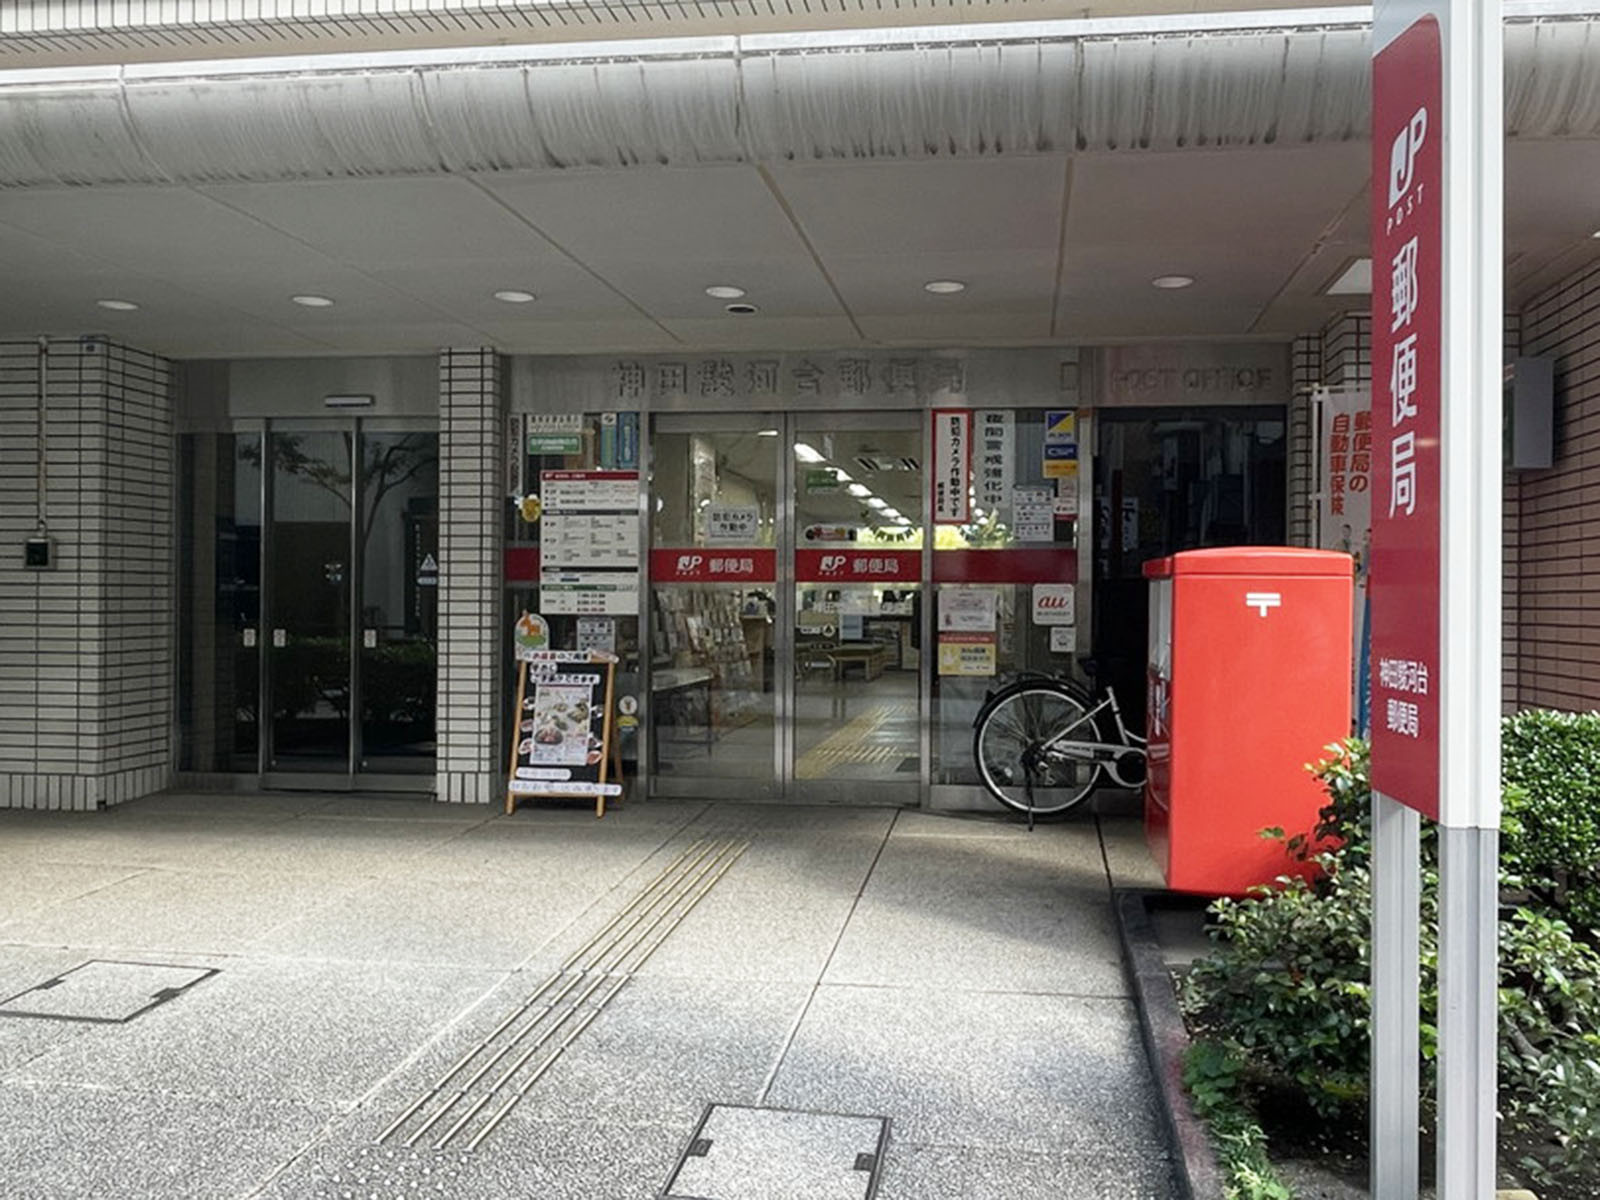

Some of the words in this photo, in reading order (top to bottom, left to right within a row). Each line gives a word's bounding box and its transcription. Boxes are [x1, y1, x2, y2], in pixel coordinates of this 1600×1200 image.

[1386, 183, 1424, 236] POST
[1390, 236, 1418, 519] 郵便局
[1330, 413, 1349, 516] 自動車保険
[1349, 411, 1371, 493] 郵便局の
[709, 557, 754, 573] 郵便局
[852, 557, 899, 573] 郵便局
[1038, 595, 1068, 609] au
[1386, 698, 1418, 738] 郵便局
